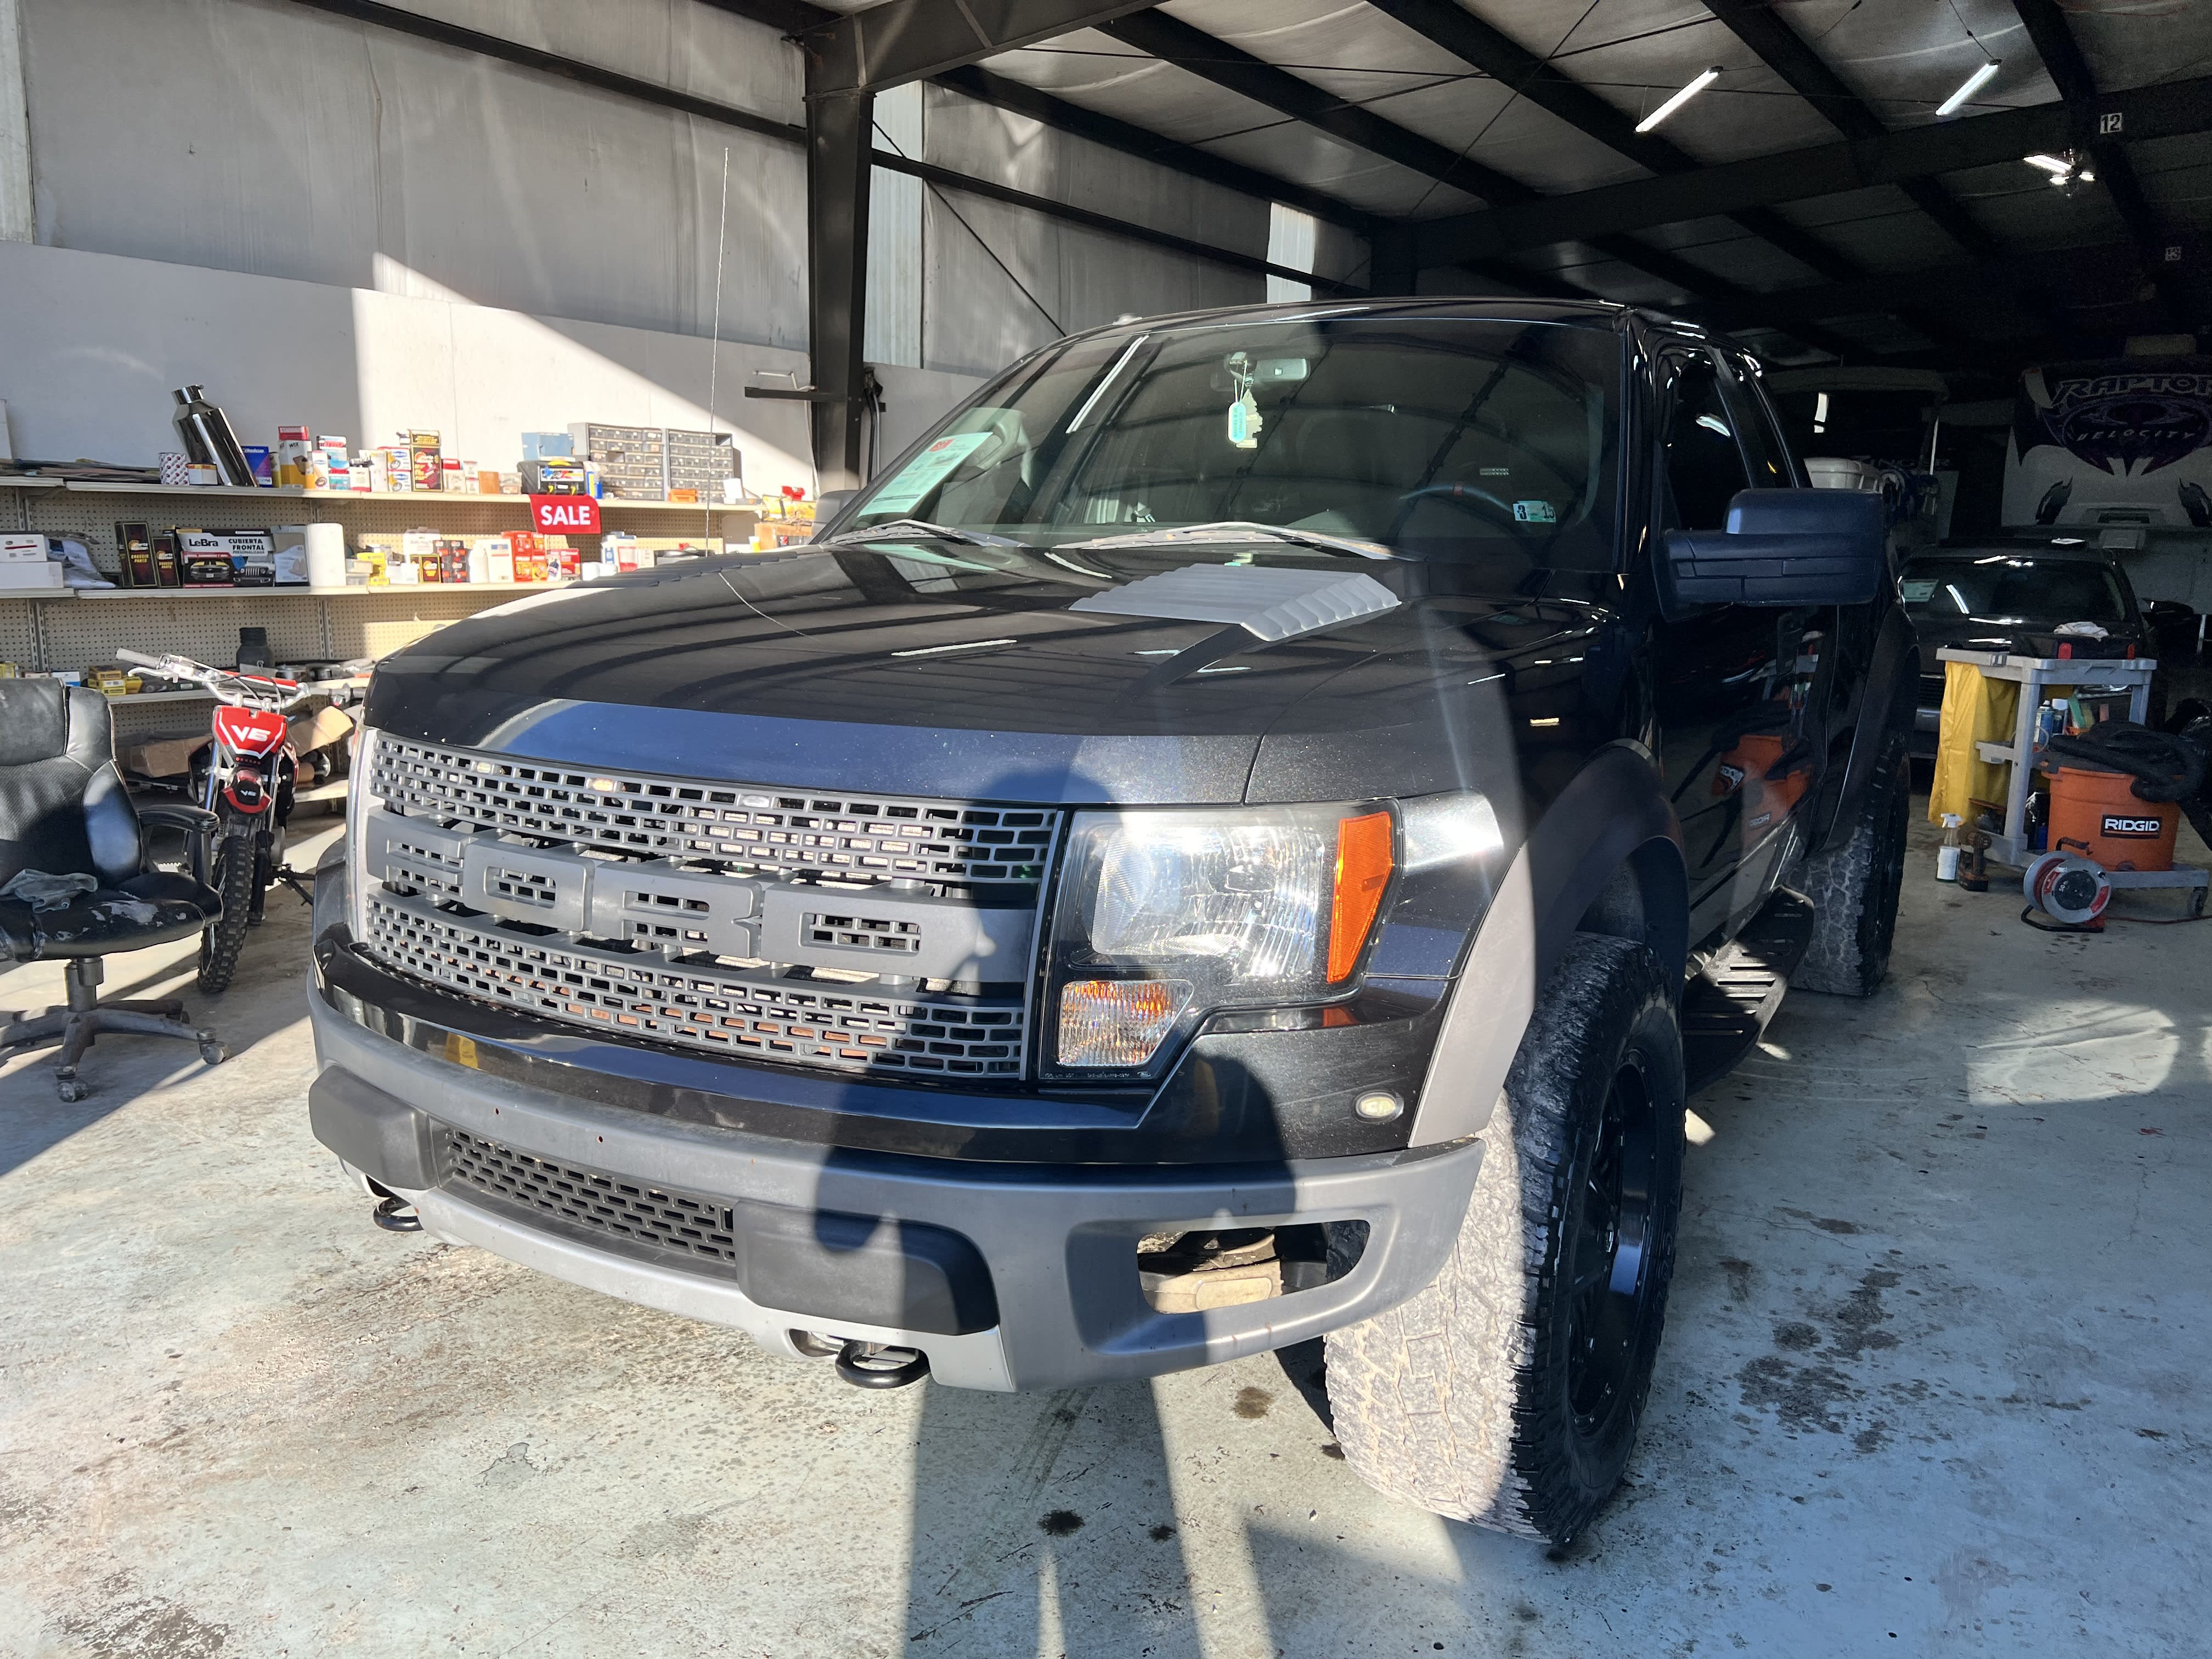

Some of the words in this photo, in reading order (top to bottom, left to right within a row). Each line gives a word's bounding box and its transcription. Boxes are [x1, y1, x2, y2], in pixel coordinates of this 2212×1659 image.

[2102, 115, 2120, 133] 12
[2076, 428, 2196, 442] VELOCITY
[540, 505, 591, 526] SALE
[2104, 819, 2160, 831] RIDGID
[367, 813, 1036, 983] FORD
